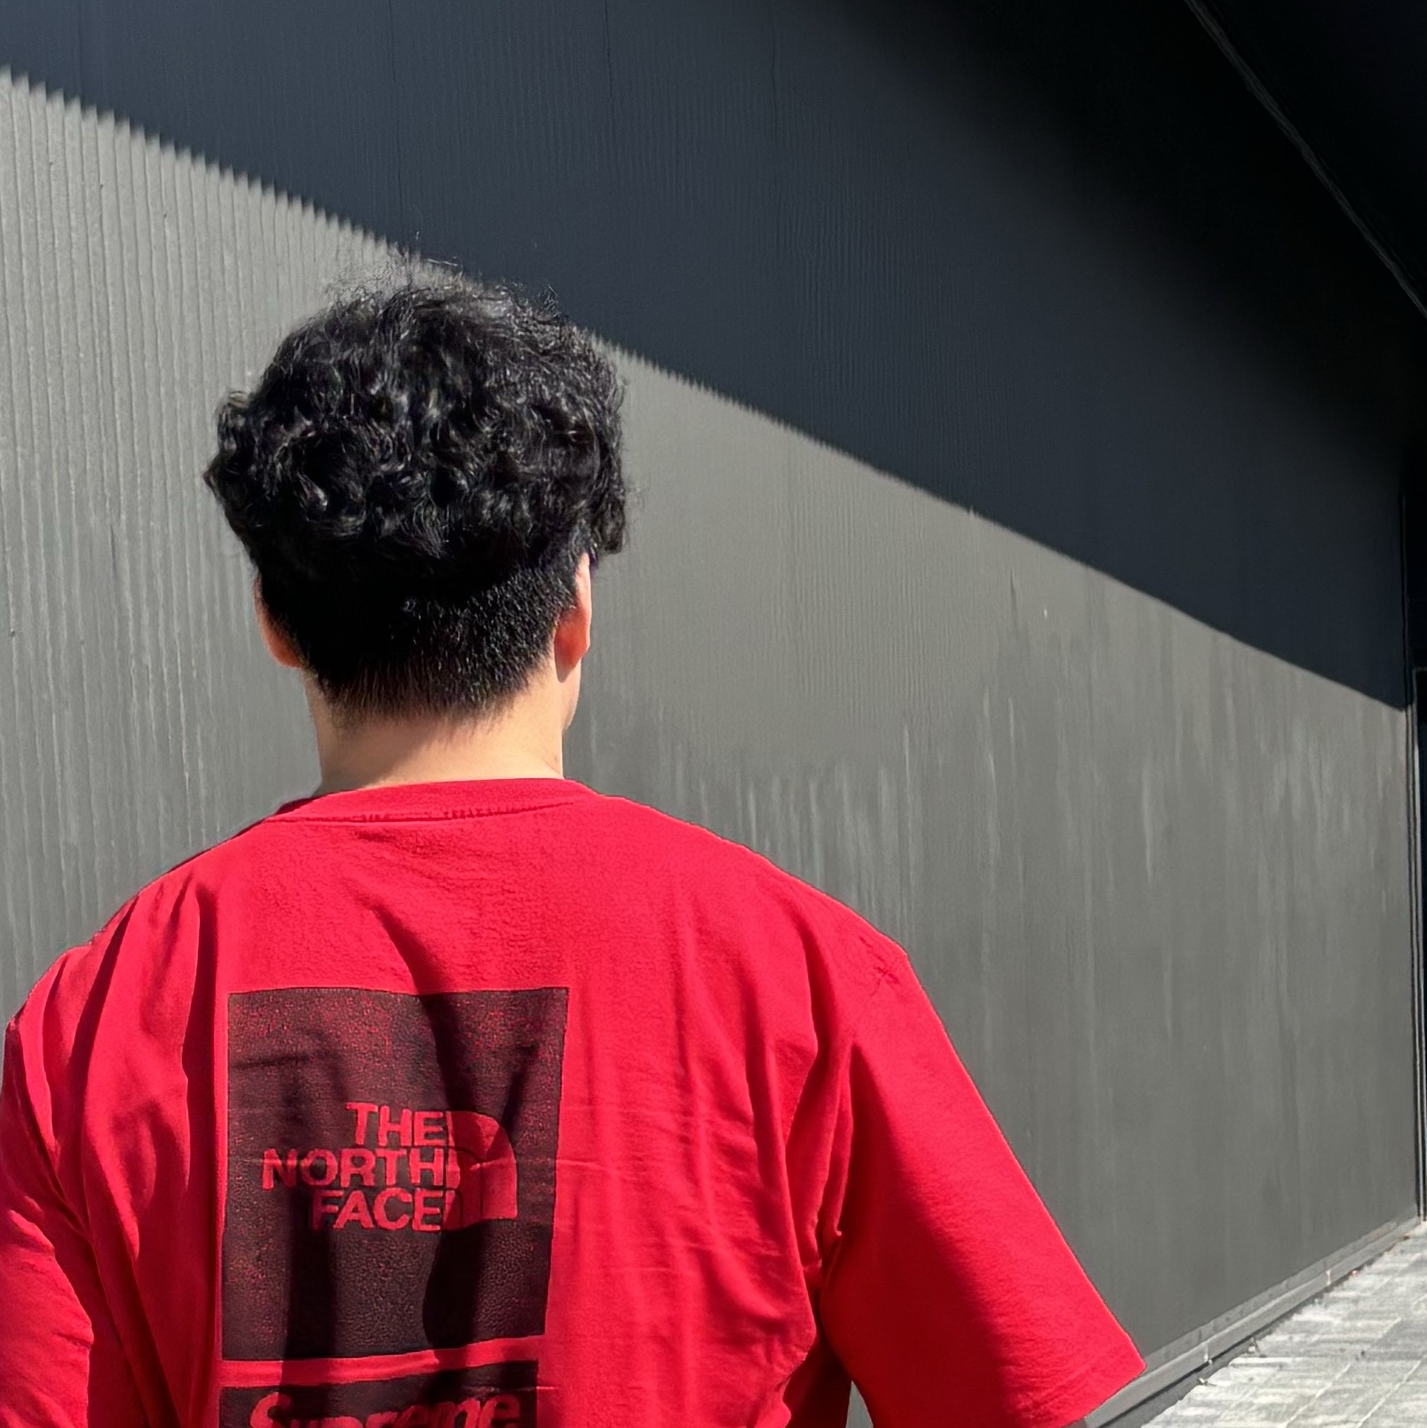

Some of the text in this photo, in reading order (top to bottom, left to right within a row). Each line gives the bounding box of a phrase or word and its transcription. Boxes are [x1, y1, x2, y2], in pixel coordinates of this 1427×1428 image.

[346, 1102, 445, 1147] THE
[262, 1148, 444, 1190] NORTH
[310, 1187, 442, 1231] FACE
